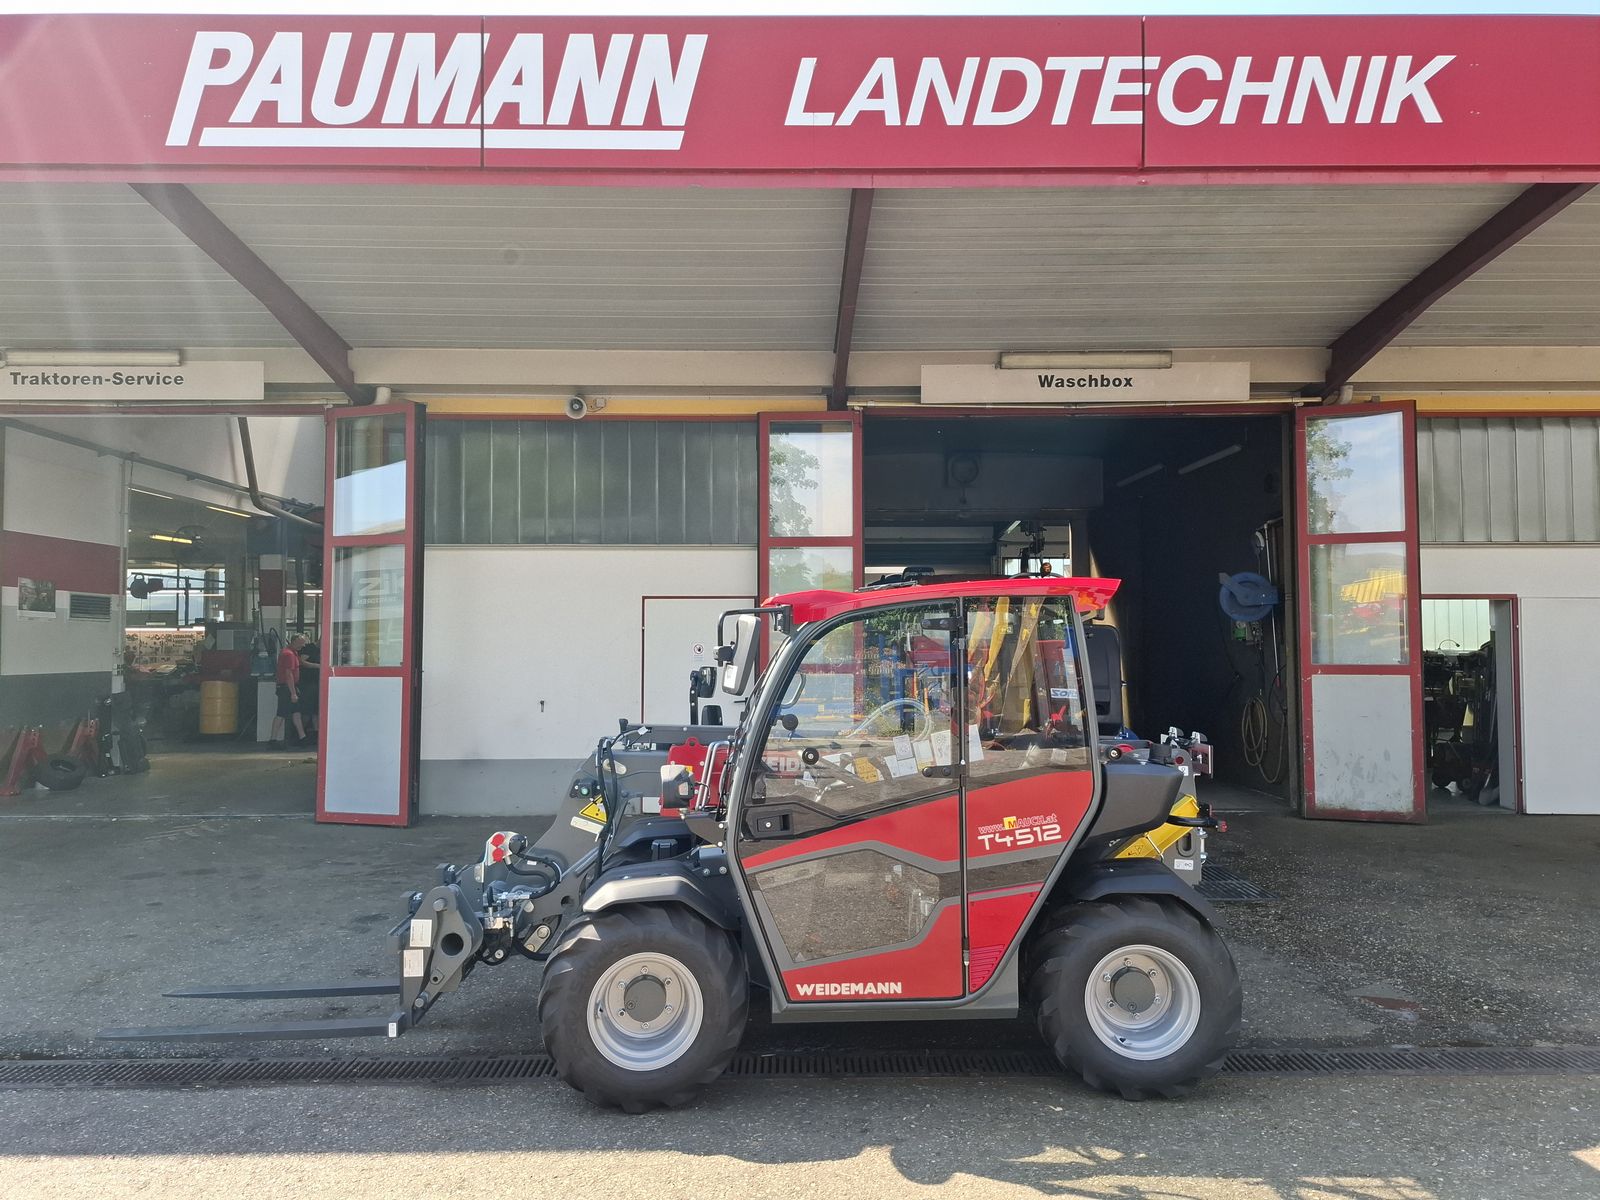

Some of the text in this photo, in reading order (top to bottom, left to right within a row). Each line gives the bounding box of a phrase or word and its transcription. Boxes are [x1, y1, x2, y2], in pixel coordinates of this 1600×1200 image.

[165, 31, 1456, 148] PAUMANN LANDTECHNIK
[10, 371, 184, 386] Traktoren-Service
[1038, 374, 1133, 388] Waschbox
[977, 824, 1062, 851] T4512
[796, 982, 903, 996] WEIDEMANN
